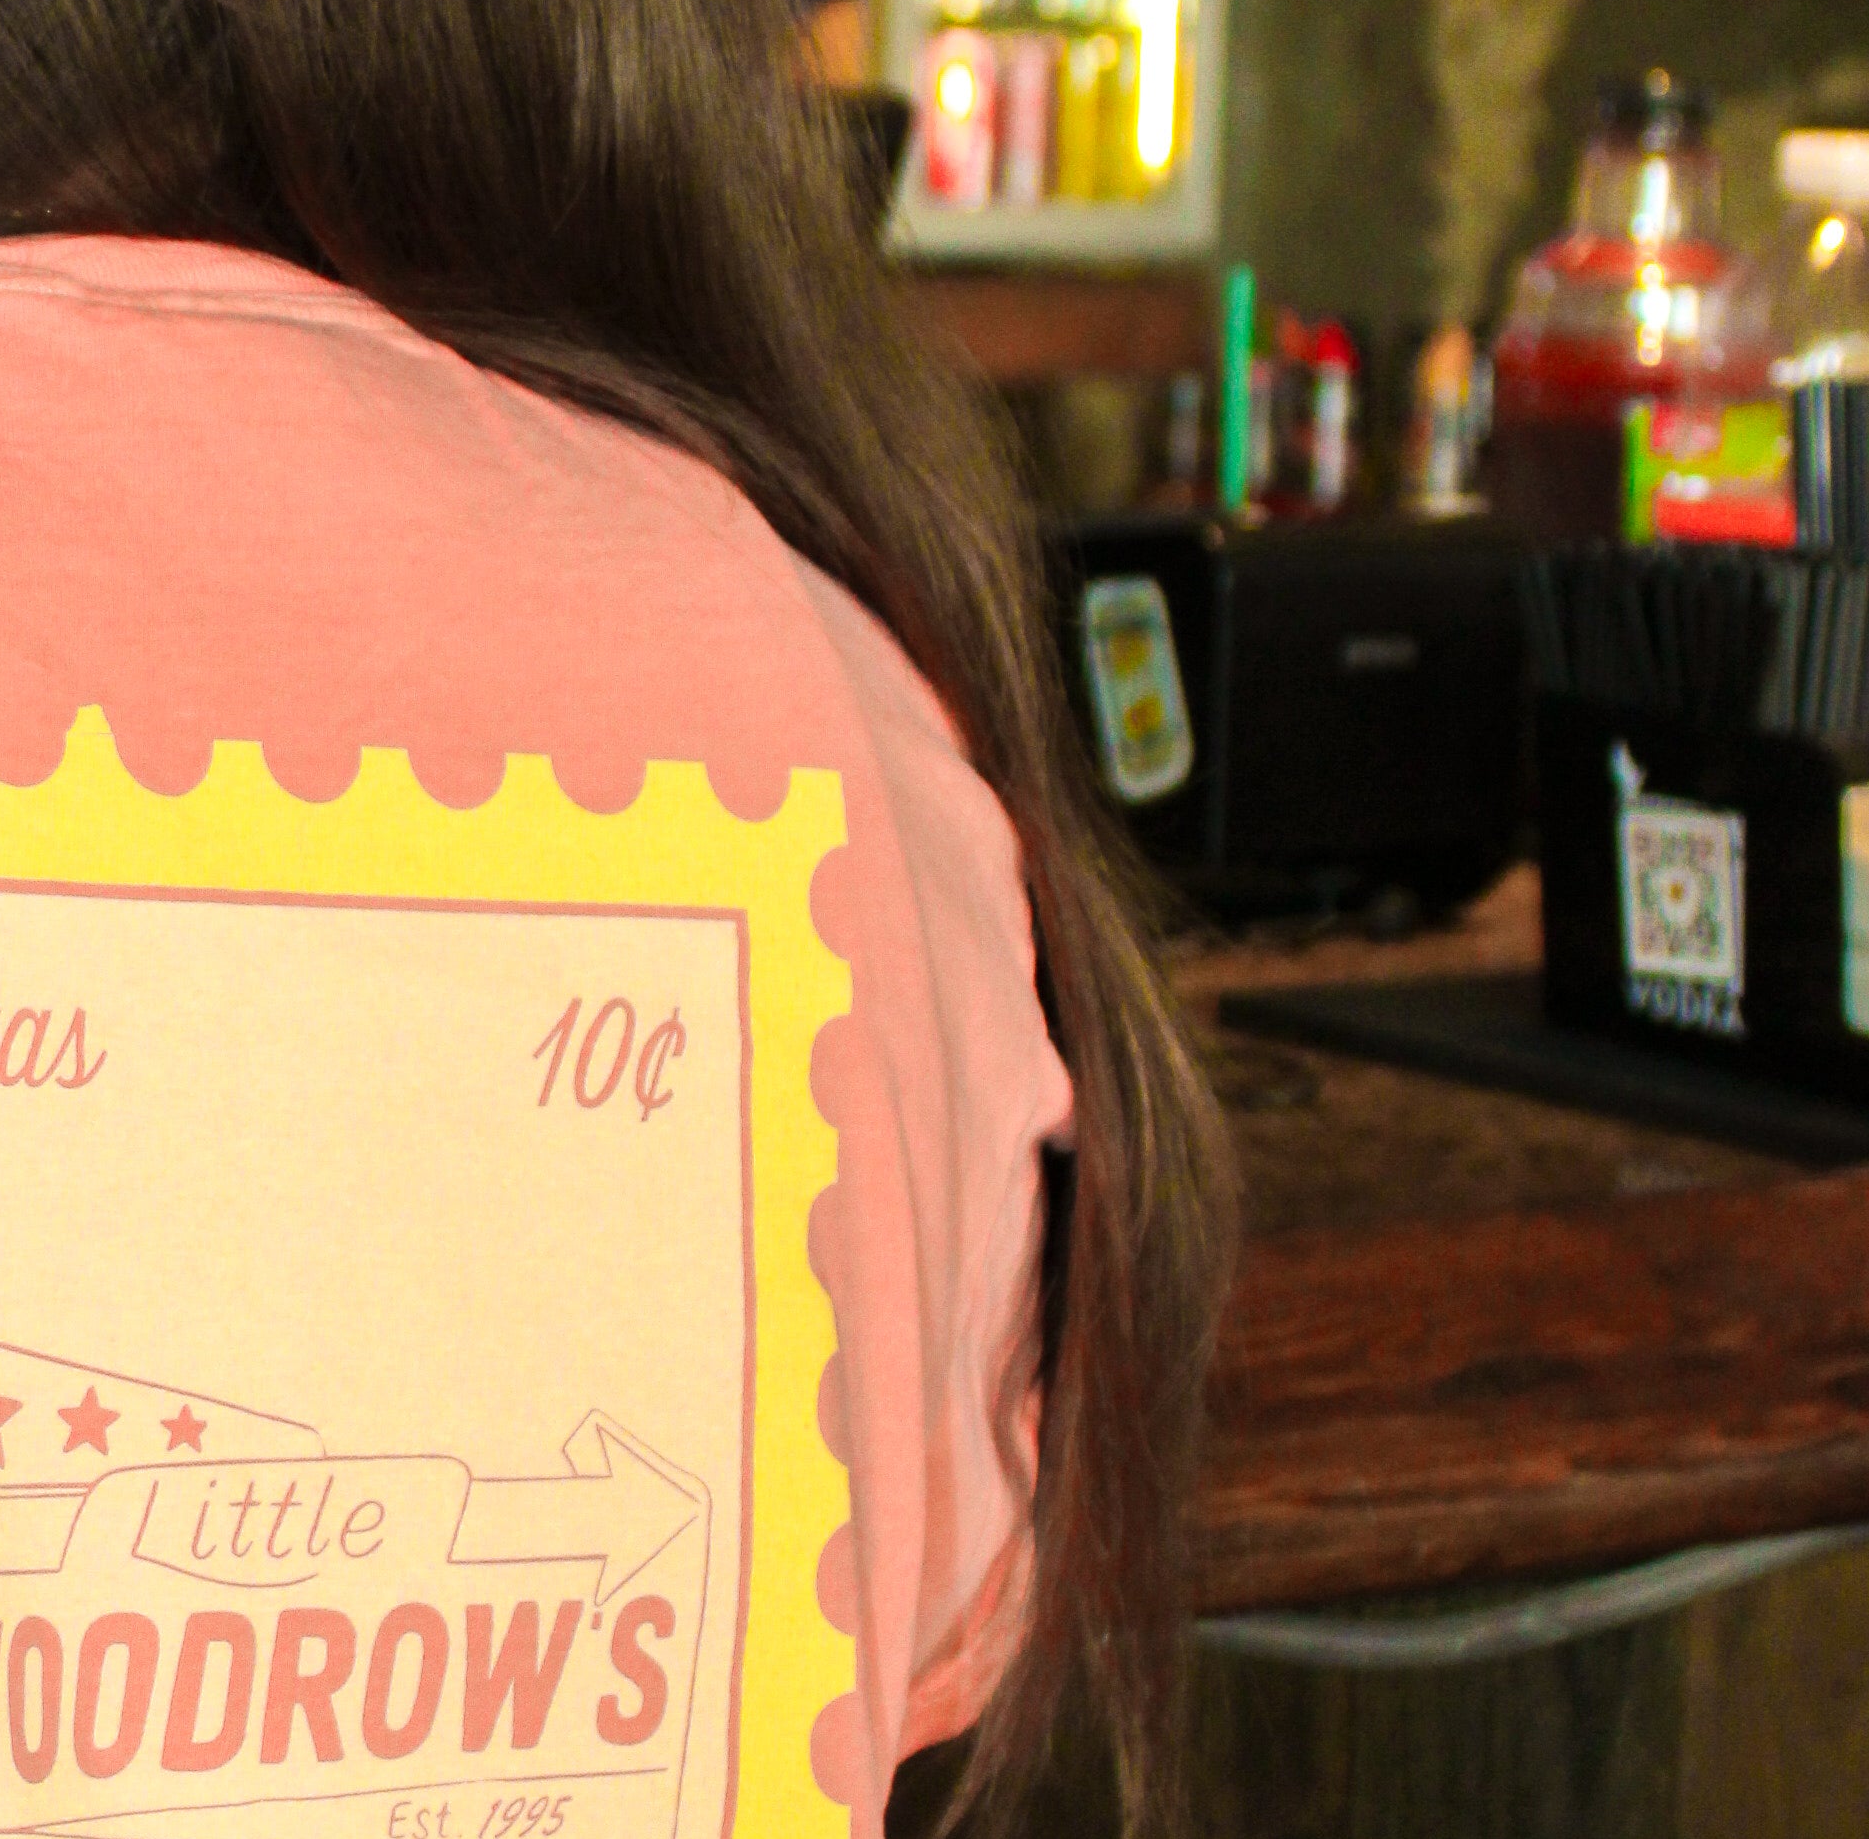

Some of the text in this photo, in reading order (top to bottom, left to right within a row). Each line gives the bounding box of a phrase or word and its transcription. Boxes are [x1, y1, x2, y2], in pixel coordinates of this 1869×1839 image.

[532, 995, 688, 1123] 10¢
[133, 1473, 386, 1586] Little
[478, 1795, 573, 1839] 1995
